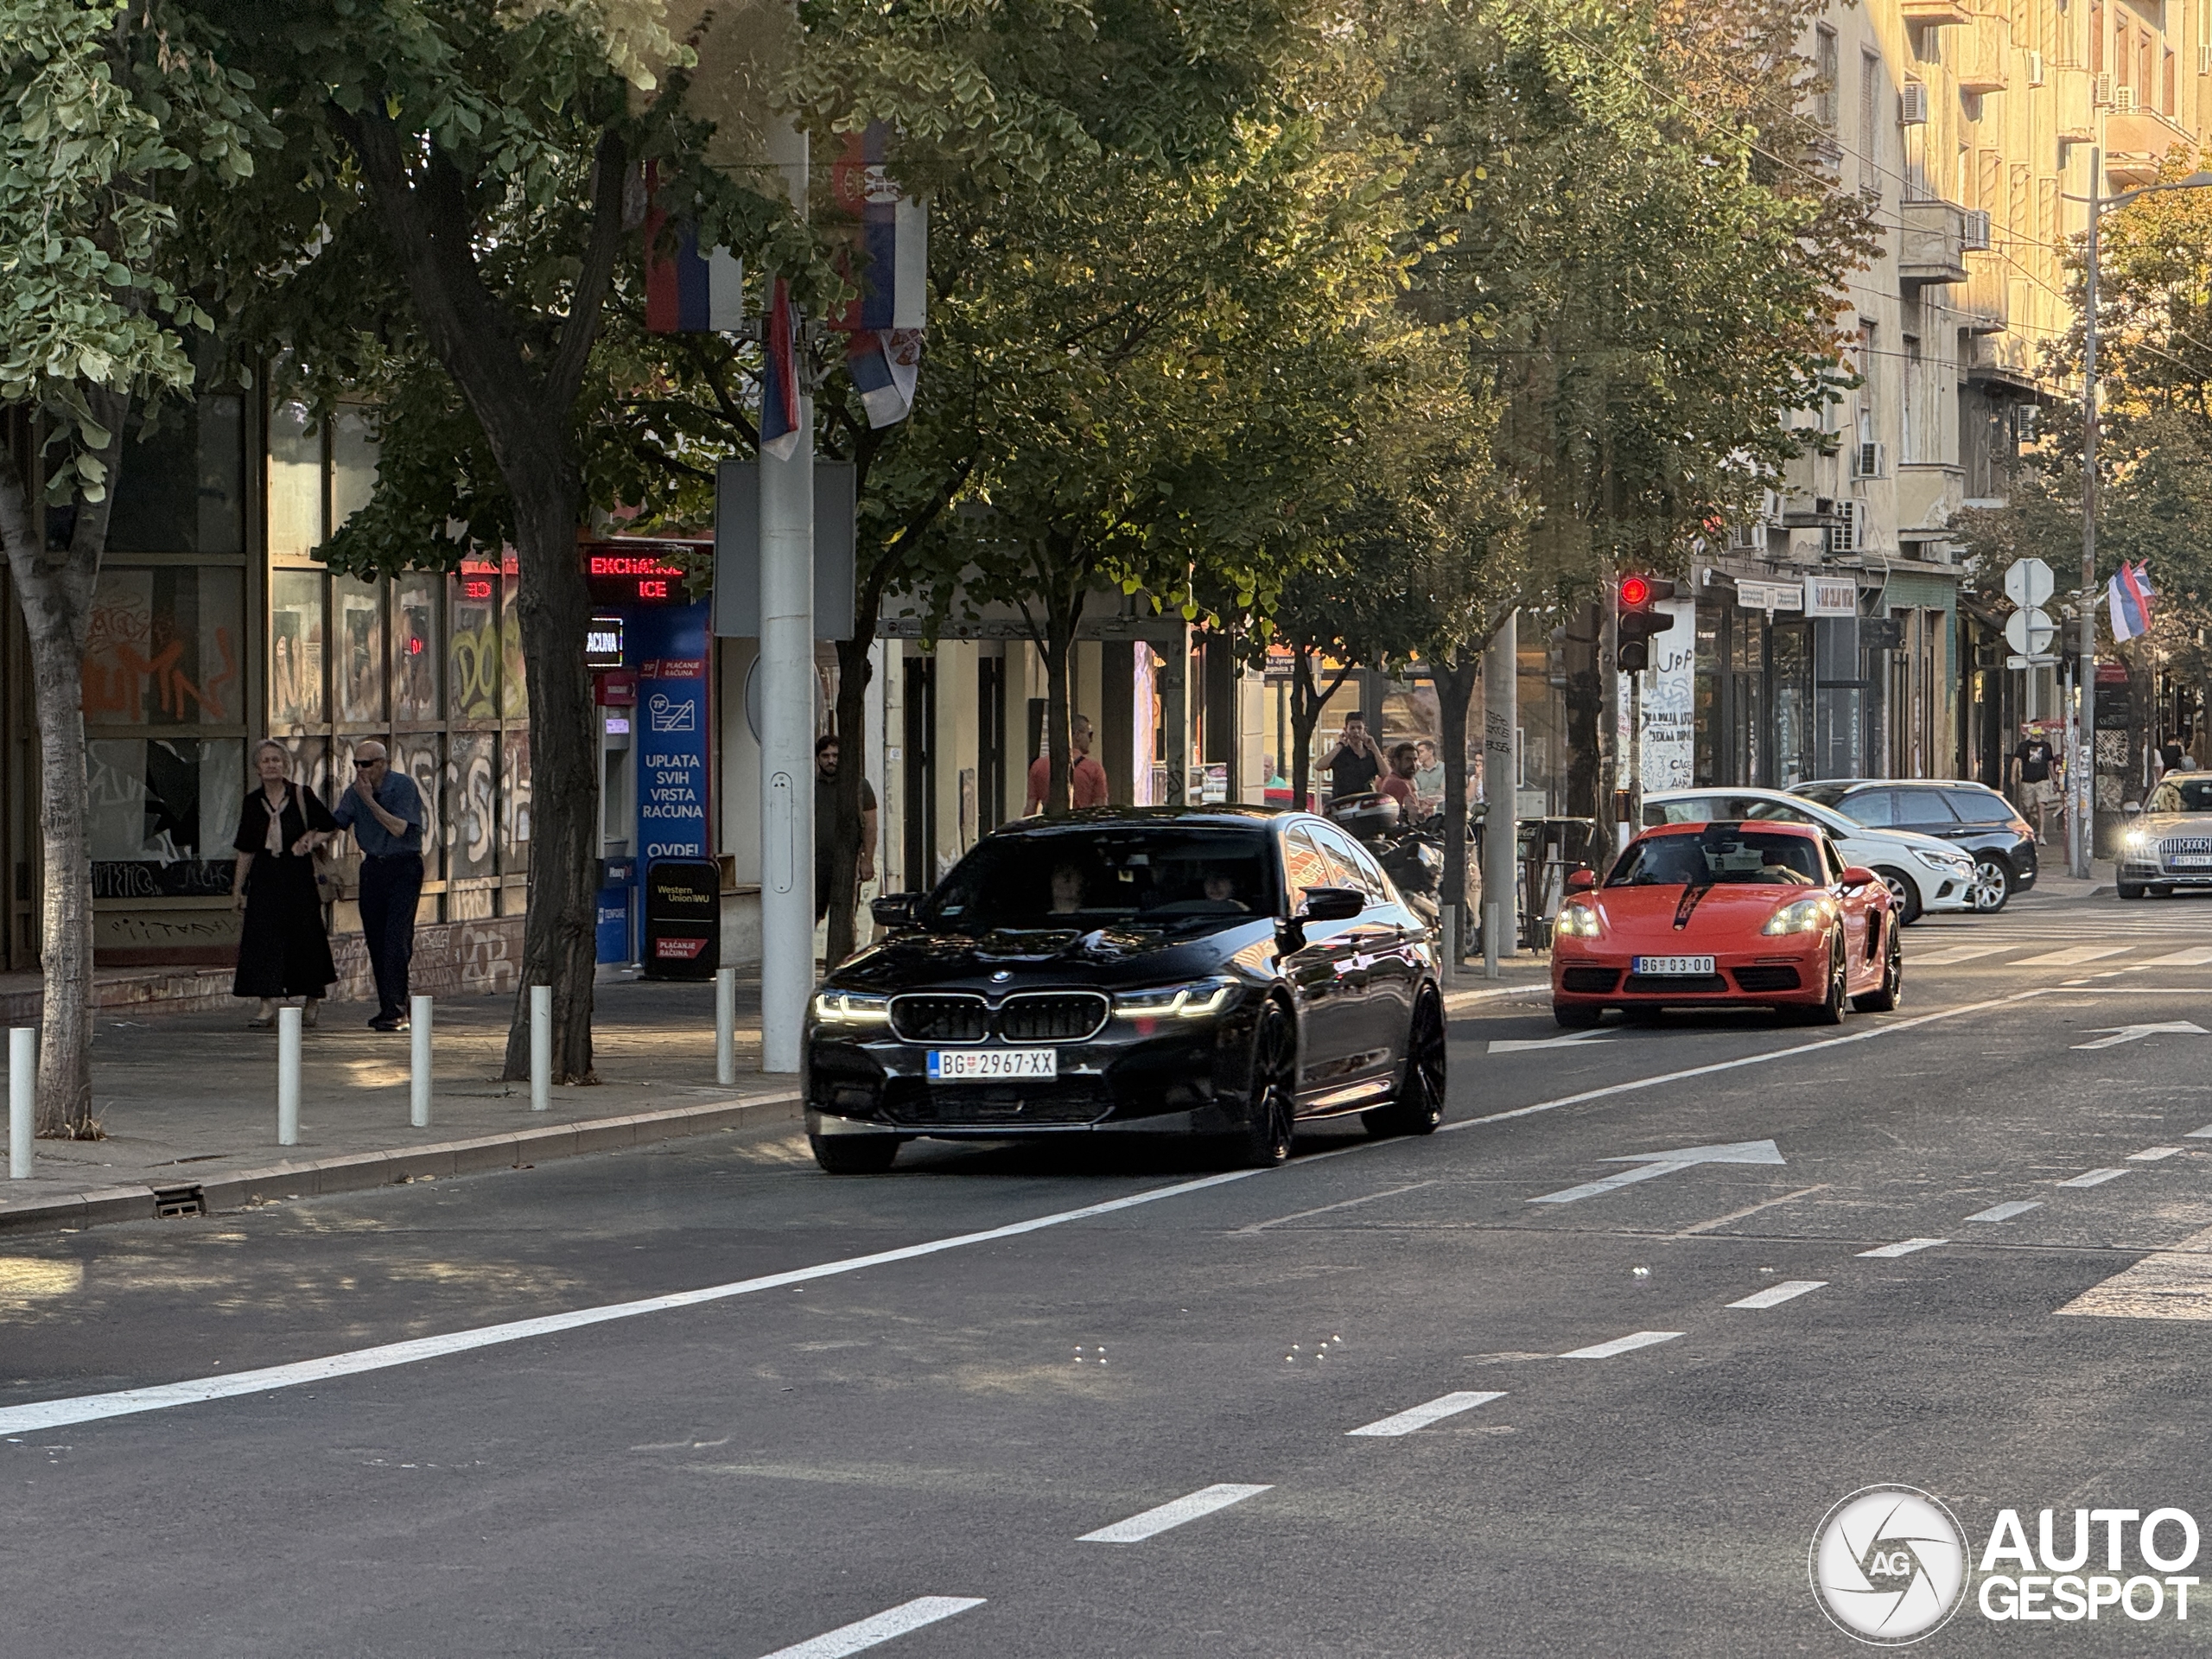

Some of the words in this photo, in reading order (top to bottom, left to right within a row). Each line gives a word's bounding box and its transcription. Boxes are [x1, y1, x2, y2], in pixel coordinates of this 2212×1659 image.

[645, 754, 700, 767] UPLATA
[656, 772, 690, 785] SVIH
[650, 788, 696, 801] VRSTA
[643, 803, 703, 818] RAČUNA
[658, 885, 693, 894] Western
[1642, 959, 1657, 971] BG
[944, 1054, 964, 1075] BG
[980, 1052, 1052, 1074] 2967-XX
